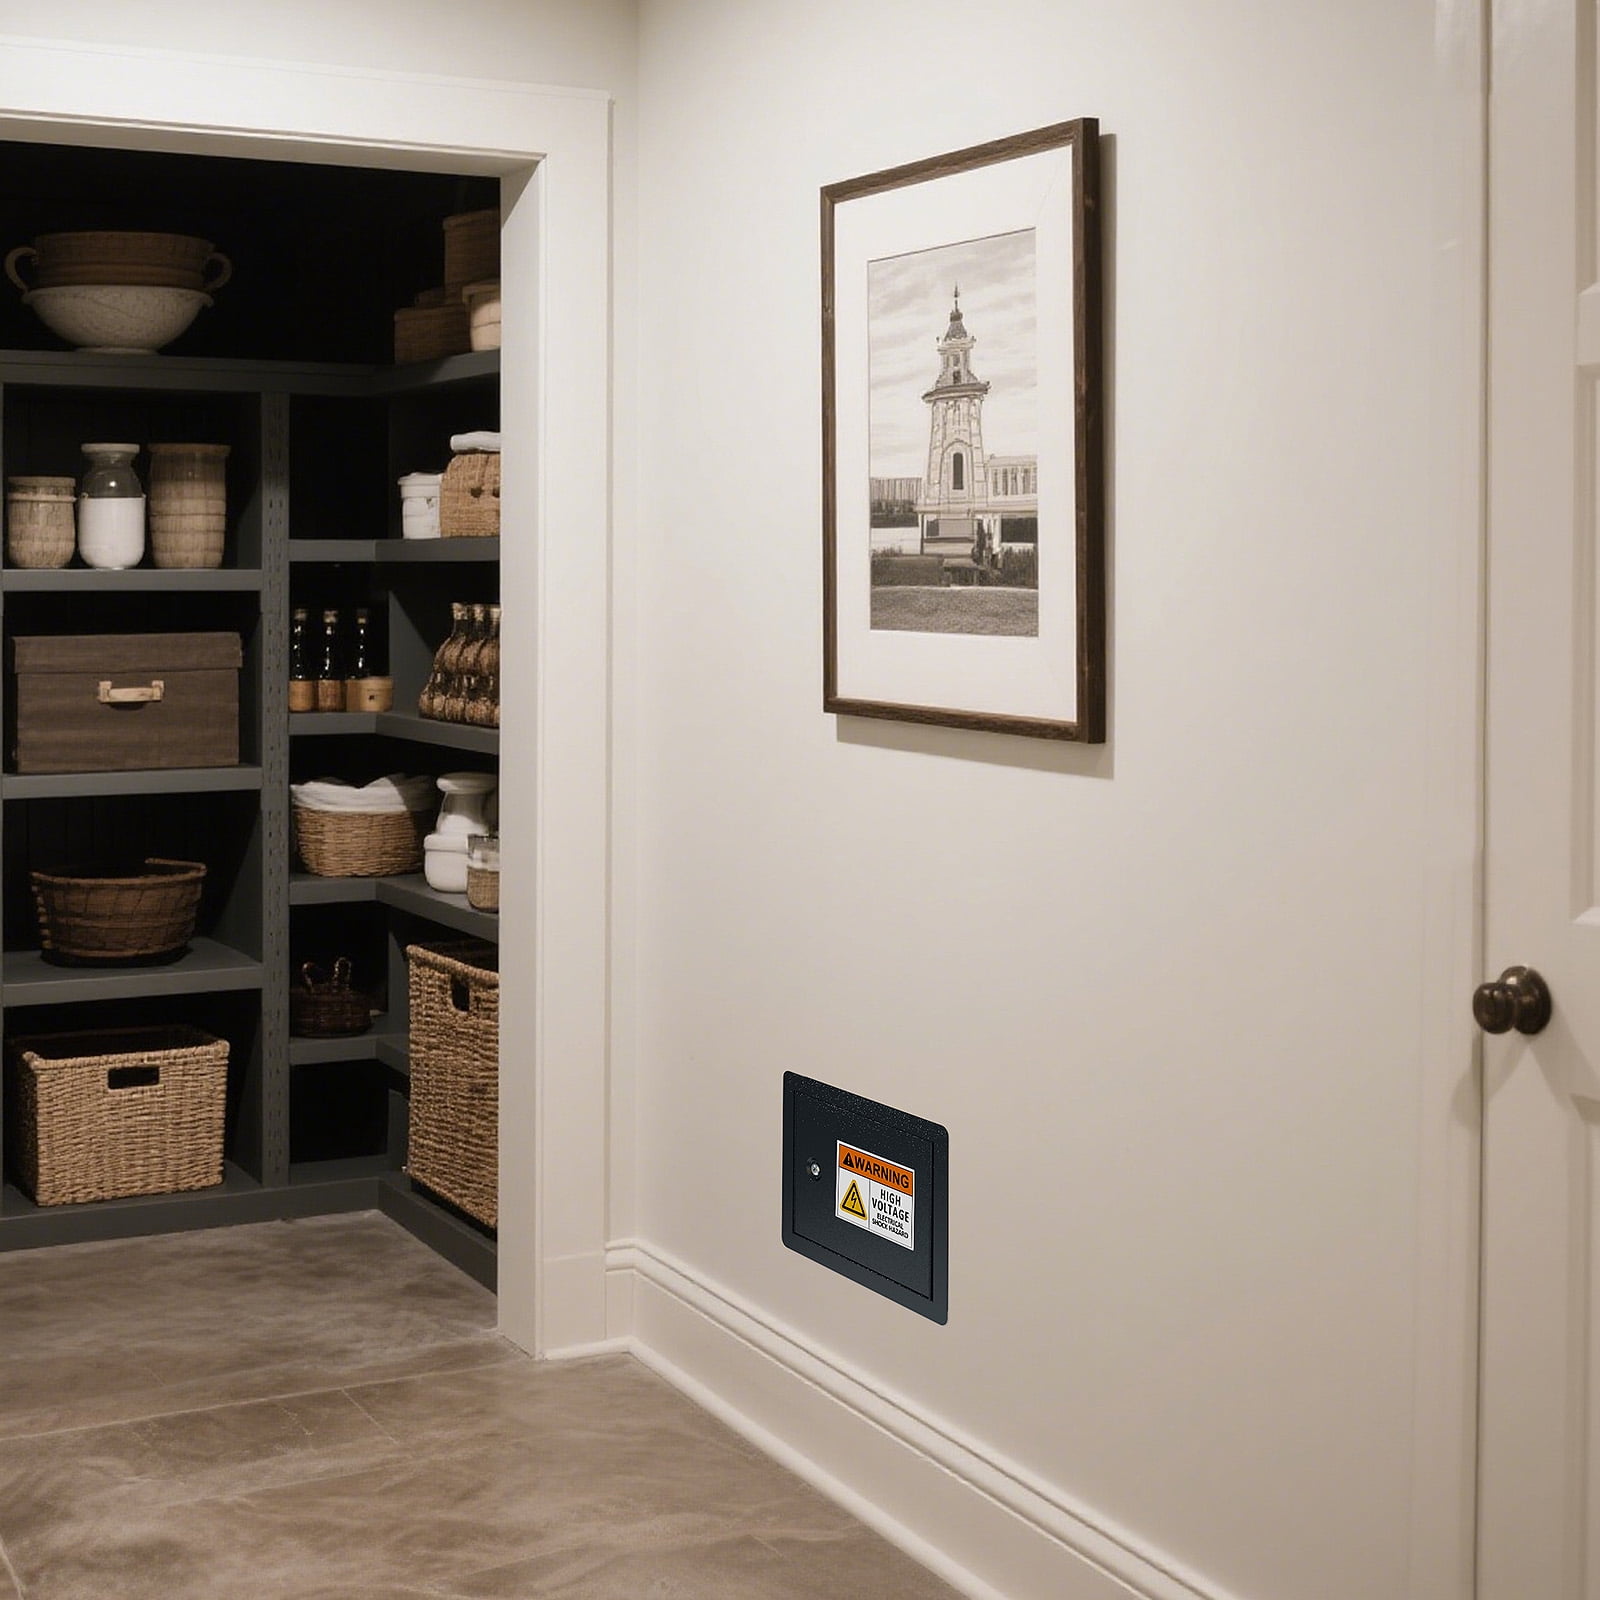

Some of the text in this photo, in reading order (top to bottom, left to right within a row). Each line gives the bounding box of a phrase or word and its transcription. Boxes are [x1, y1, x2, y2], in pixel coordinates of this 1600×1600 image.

[854, 1156, 909, 1188] WARNING
[880, 1189, 901, 1206] HIGH
[871, 1197, 910, 1223] VOLTAGE
[872, 1218, 909, 1239] SHOCK HAZARD
[876, 1212, 904, 1230] ELECTRICAL
